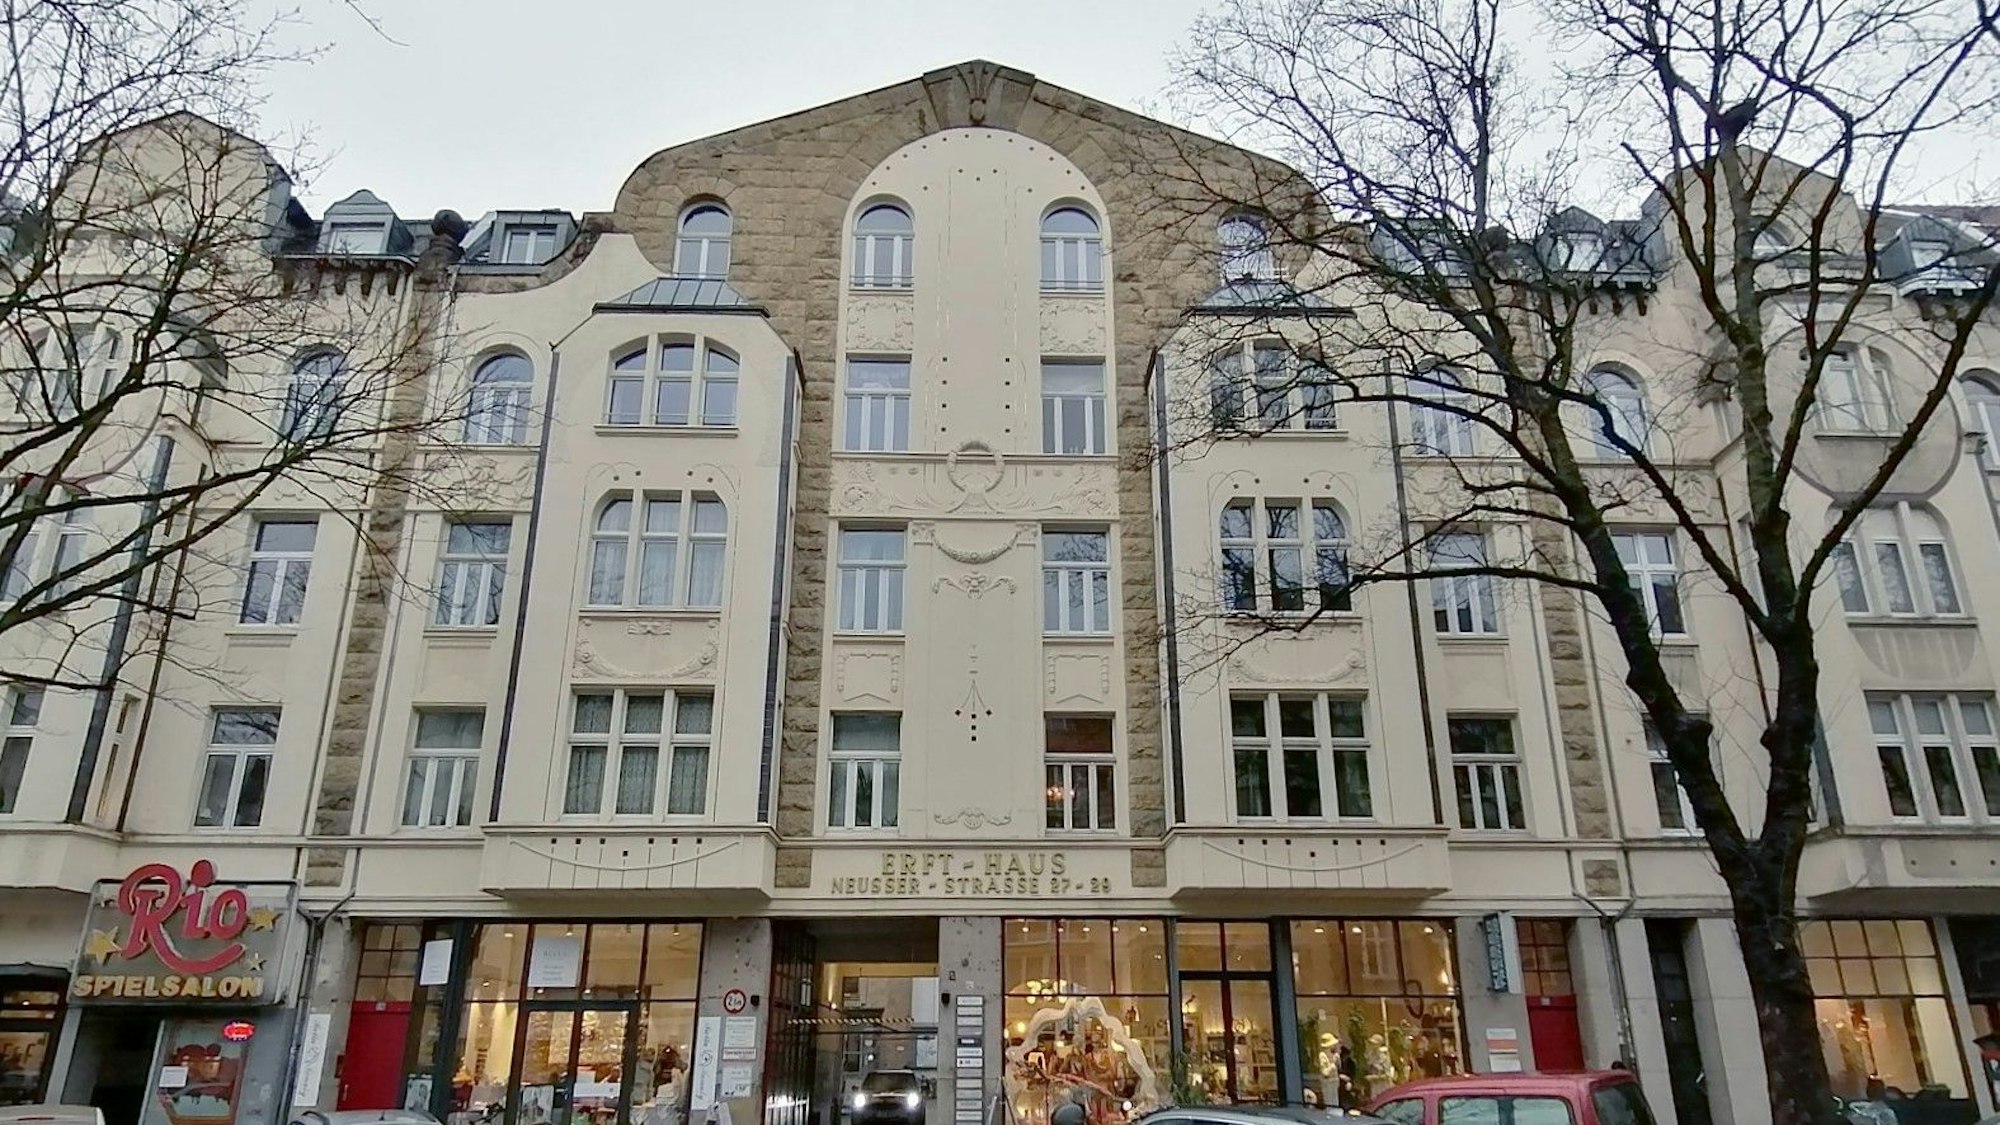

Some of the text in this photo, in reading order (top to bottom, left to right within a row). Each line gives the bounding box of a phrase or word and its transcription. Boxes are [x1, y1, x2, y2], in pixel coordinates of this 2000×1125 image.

[882, 853, 954, 875] ERFT
[984, 853, 1065, 875] HAUS
[831, 877, 920, 894] NEUSSER
[944, 877, 1039, 894] STRASSE
[118, 859, 247, 974] Rio
[74, 974, 264, 997] SPIELSALON
